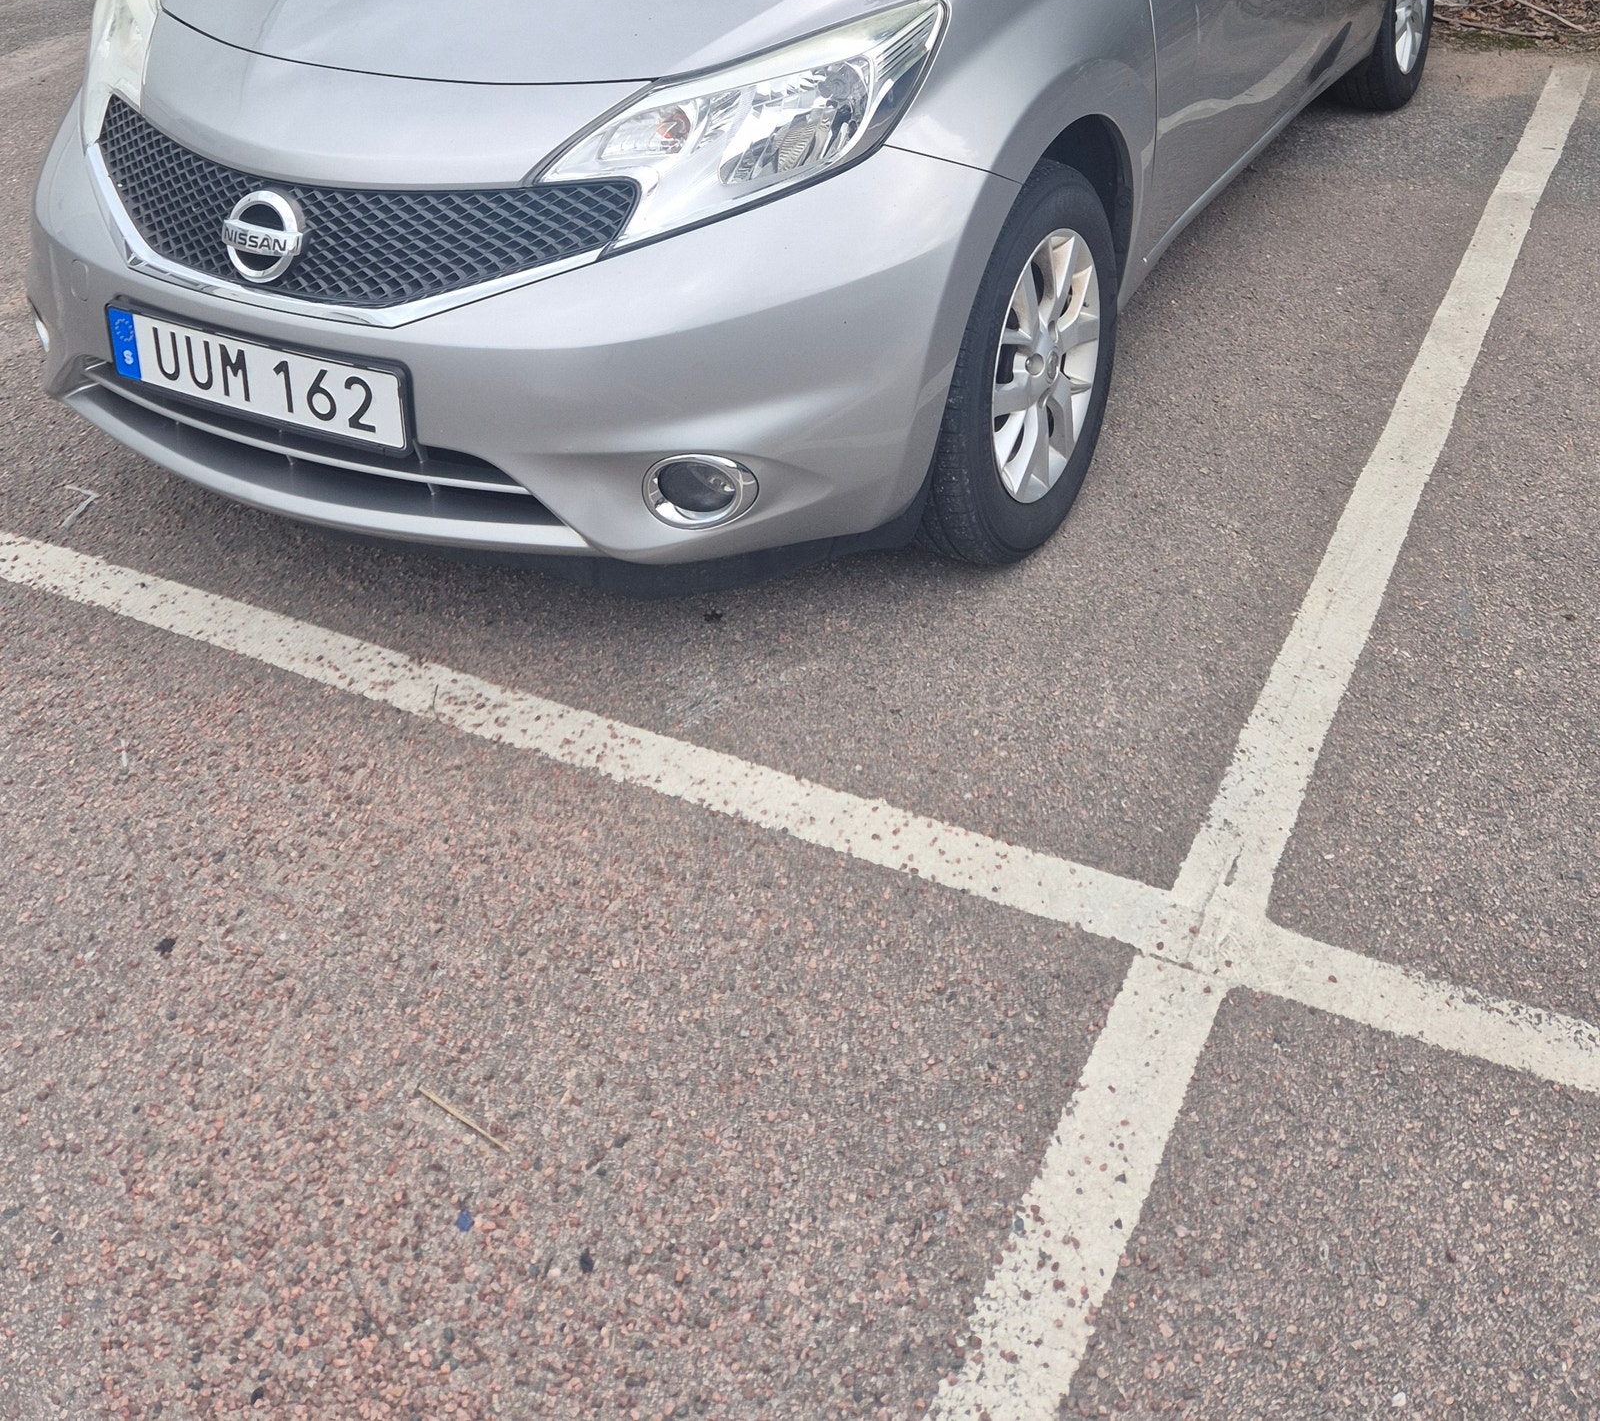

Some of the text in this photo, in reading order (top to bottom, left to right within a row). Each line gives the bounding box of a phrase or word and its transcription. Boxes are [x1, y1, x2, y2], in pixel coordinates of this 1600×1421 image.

[223, 227, 287, 252] NISSAN
[123, 350, 134, 365] S
[152, 326, 376, 433] UUM 162
